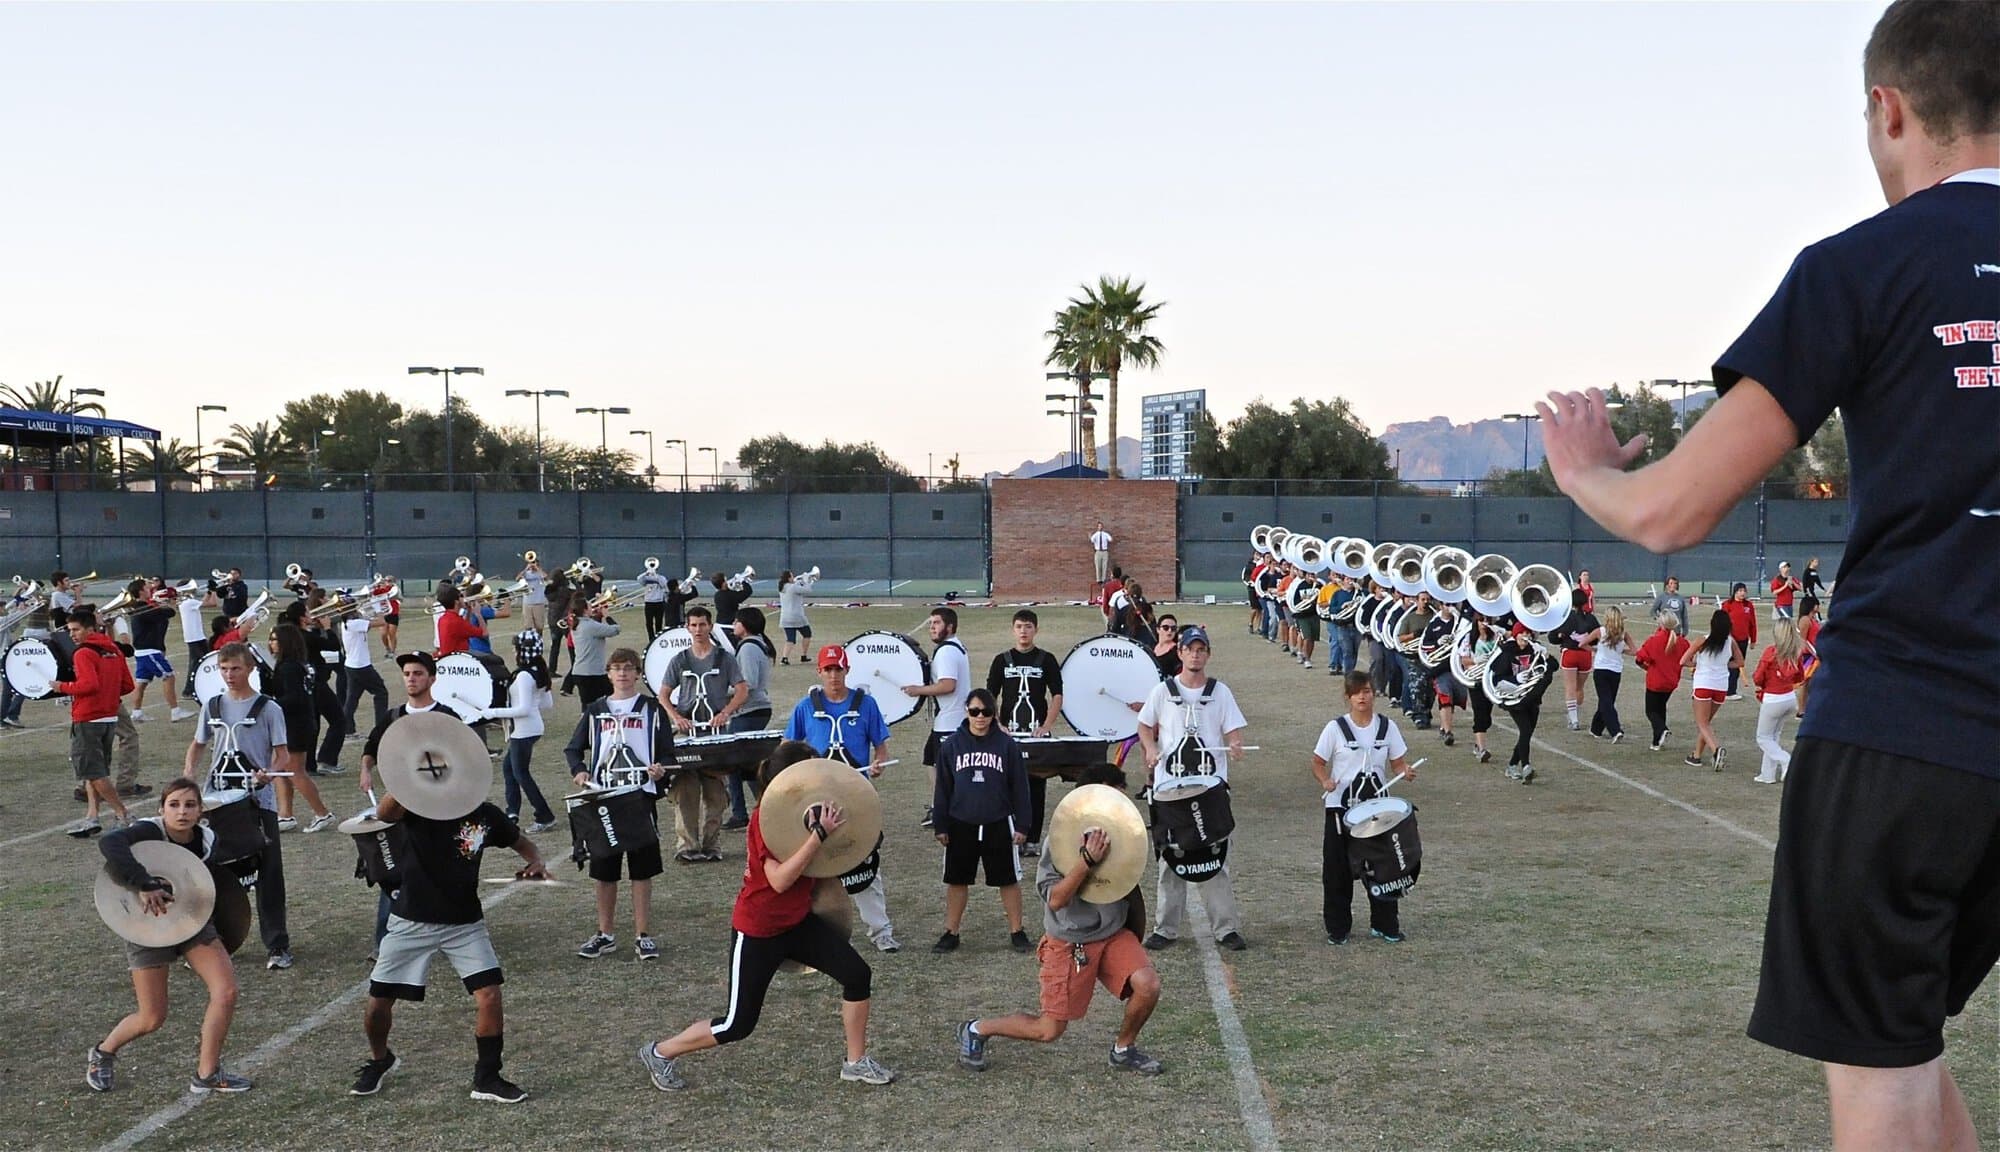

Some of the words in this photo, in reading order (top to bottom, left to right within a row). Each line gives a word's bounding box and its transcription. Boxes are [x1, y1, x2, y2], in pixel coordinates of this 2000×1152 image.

[1965, 320, 1996, 341] THE
[1954, 366, 1989, 388] THE
[103, 427, 124, 437] TENNIS
[131, 430, 153, 439] CENTER
[670, 638, 692, 648] YAMA
[866, 645, 900, 654] YAMAHA
[21, 648, 47, 656] YAMAHA
[1100, 648, 1134, 659] YAMAHA
[447, 666, 480, 677] YAMAHA
[956, 752, 1003, 773] ARIZONA
[600, 814, 618, 847] YAMAHA
[1193, 809, 1207, 841] YAMAHA
[1187, 859, 1221, 874] YAMAHA
[841, 870, 874, 887] YAMAHA
[1380, 875, 1414, 894] YAMAHA
